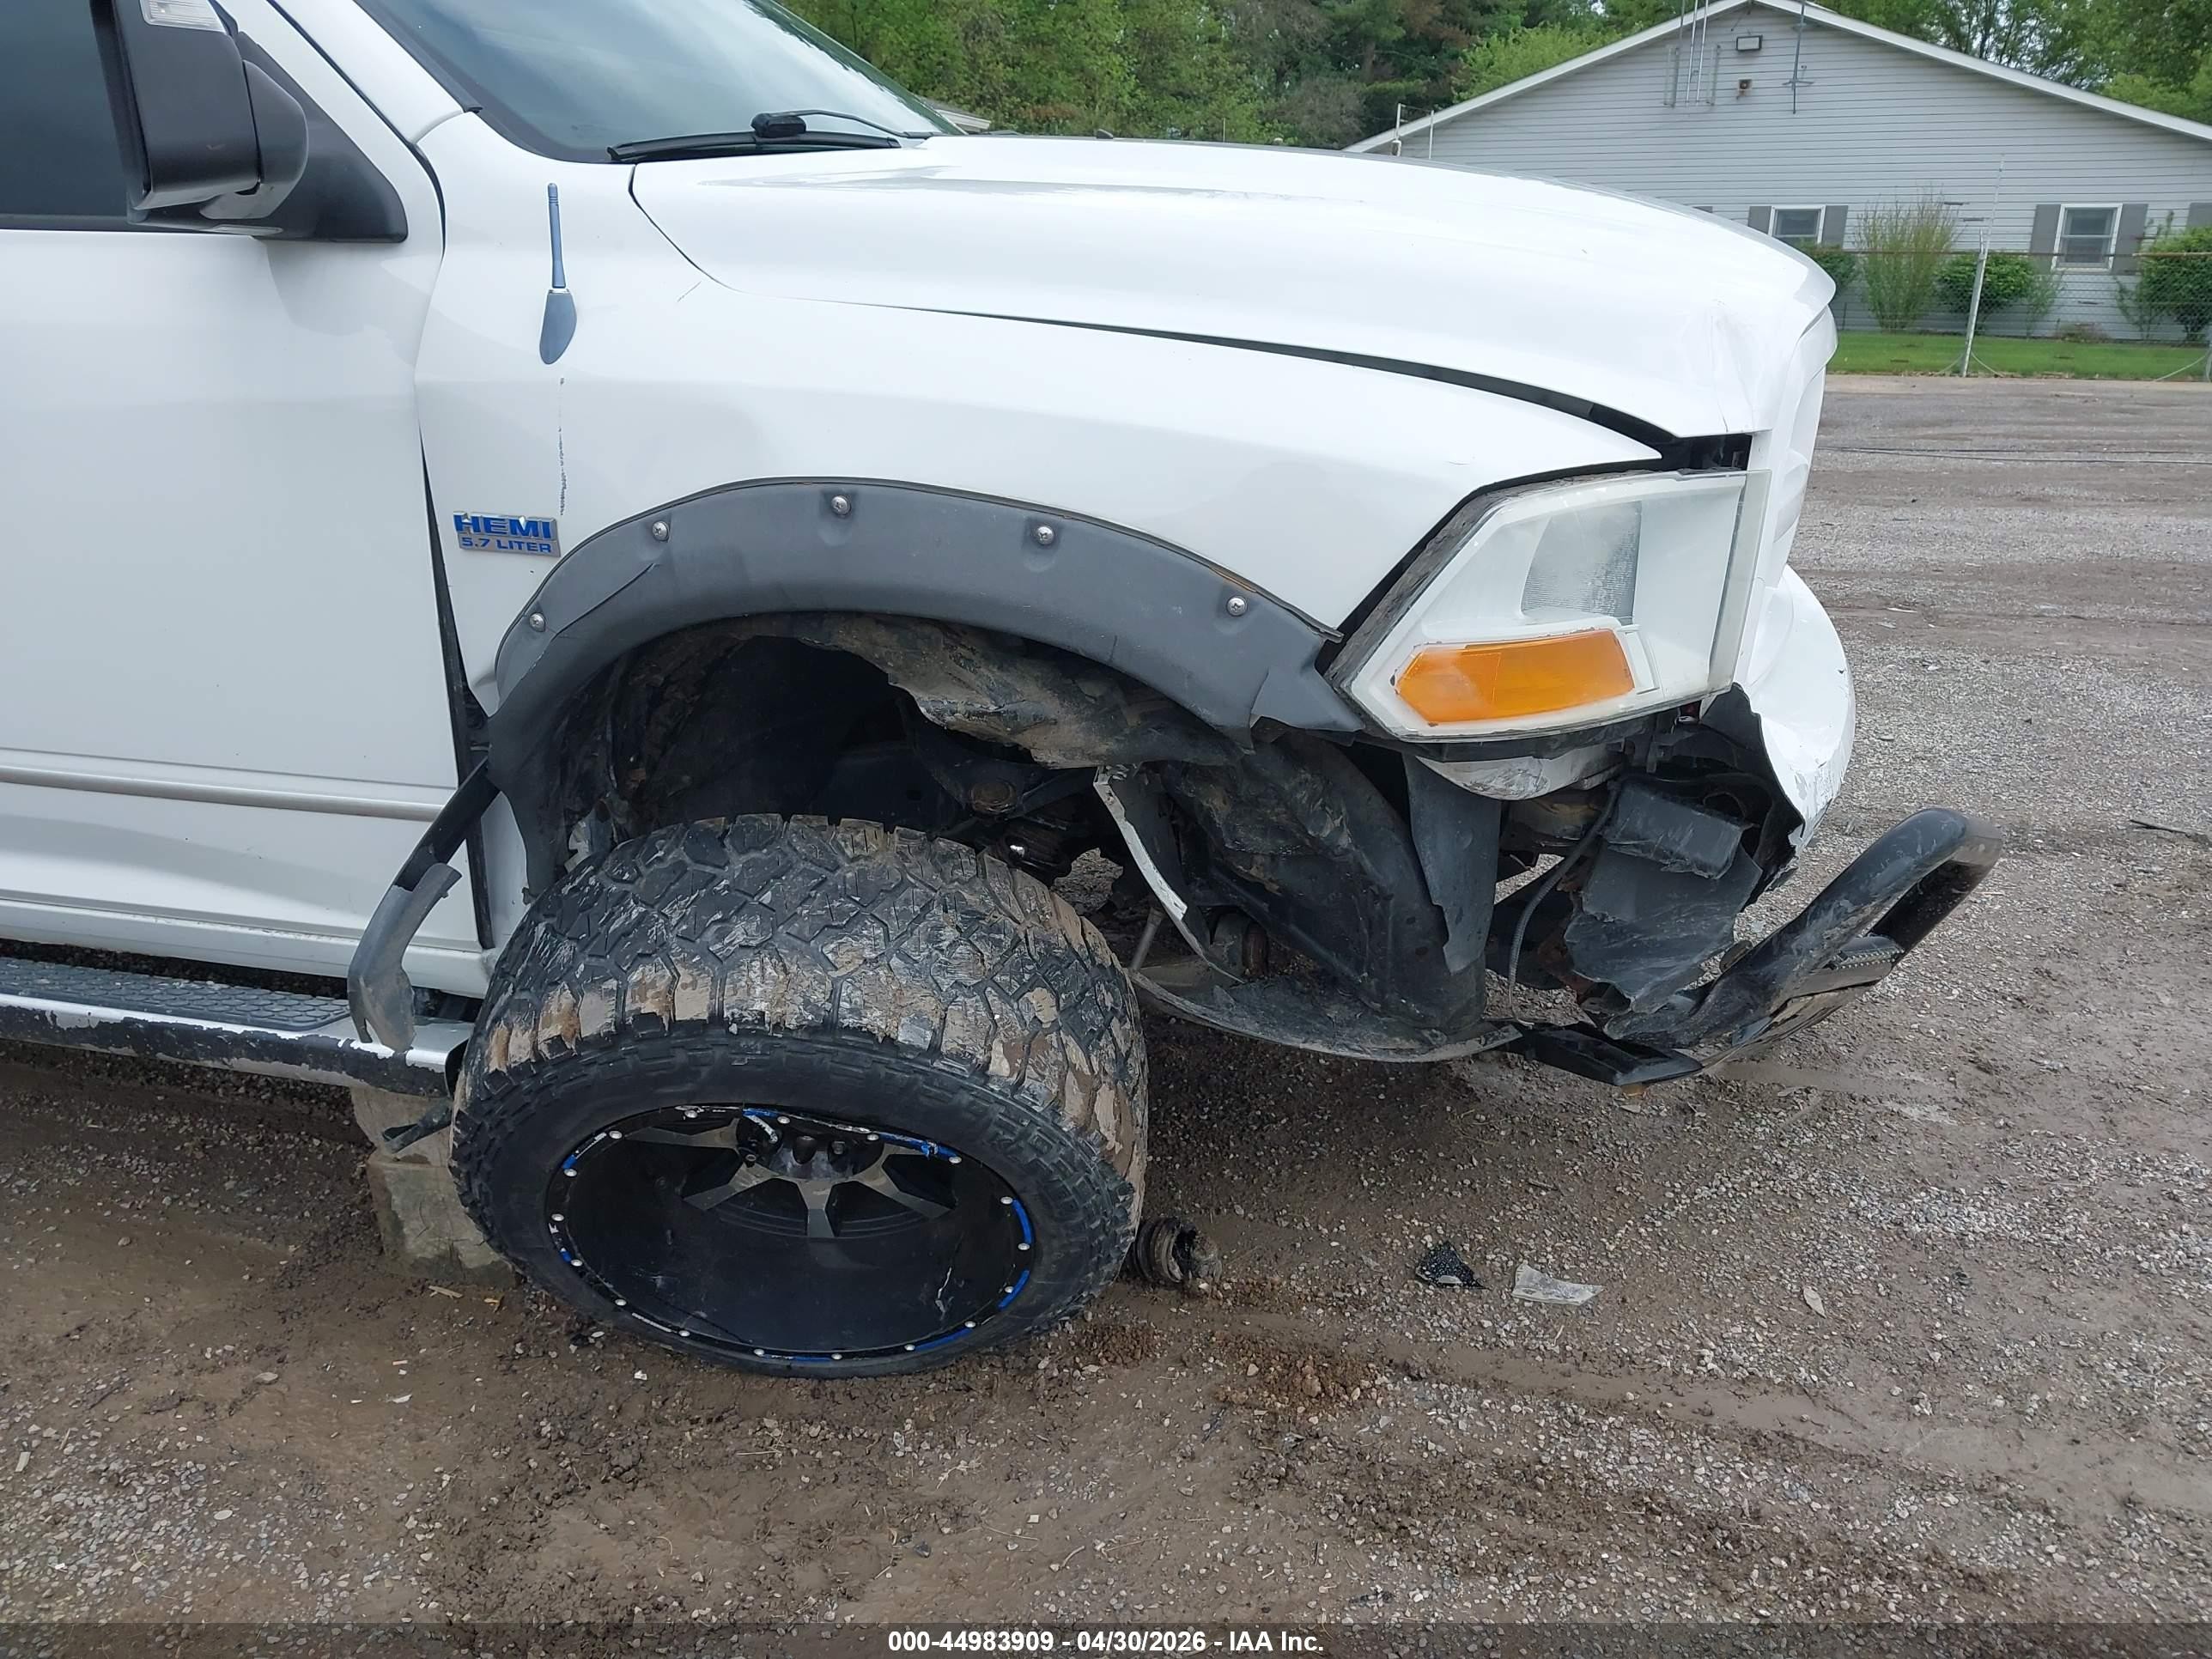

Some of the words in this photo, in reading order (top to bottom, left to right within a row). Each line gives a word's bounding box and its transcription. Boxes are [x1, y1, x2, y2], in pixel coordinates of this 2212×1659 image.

[453, 514, 552, 538] HEMI
[461, 537, 490, 548] 5.7
[496, 539, 551, 553] LITER
